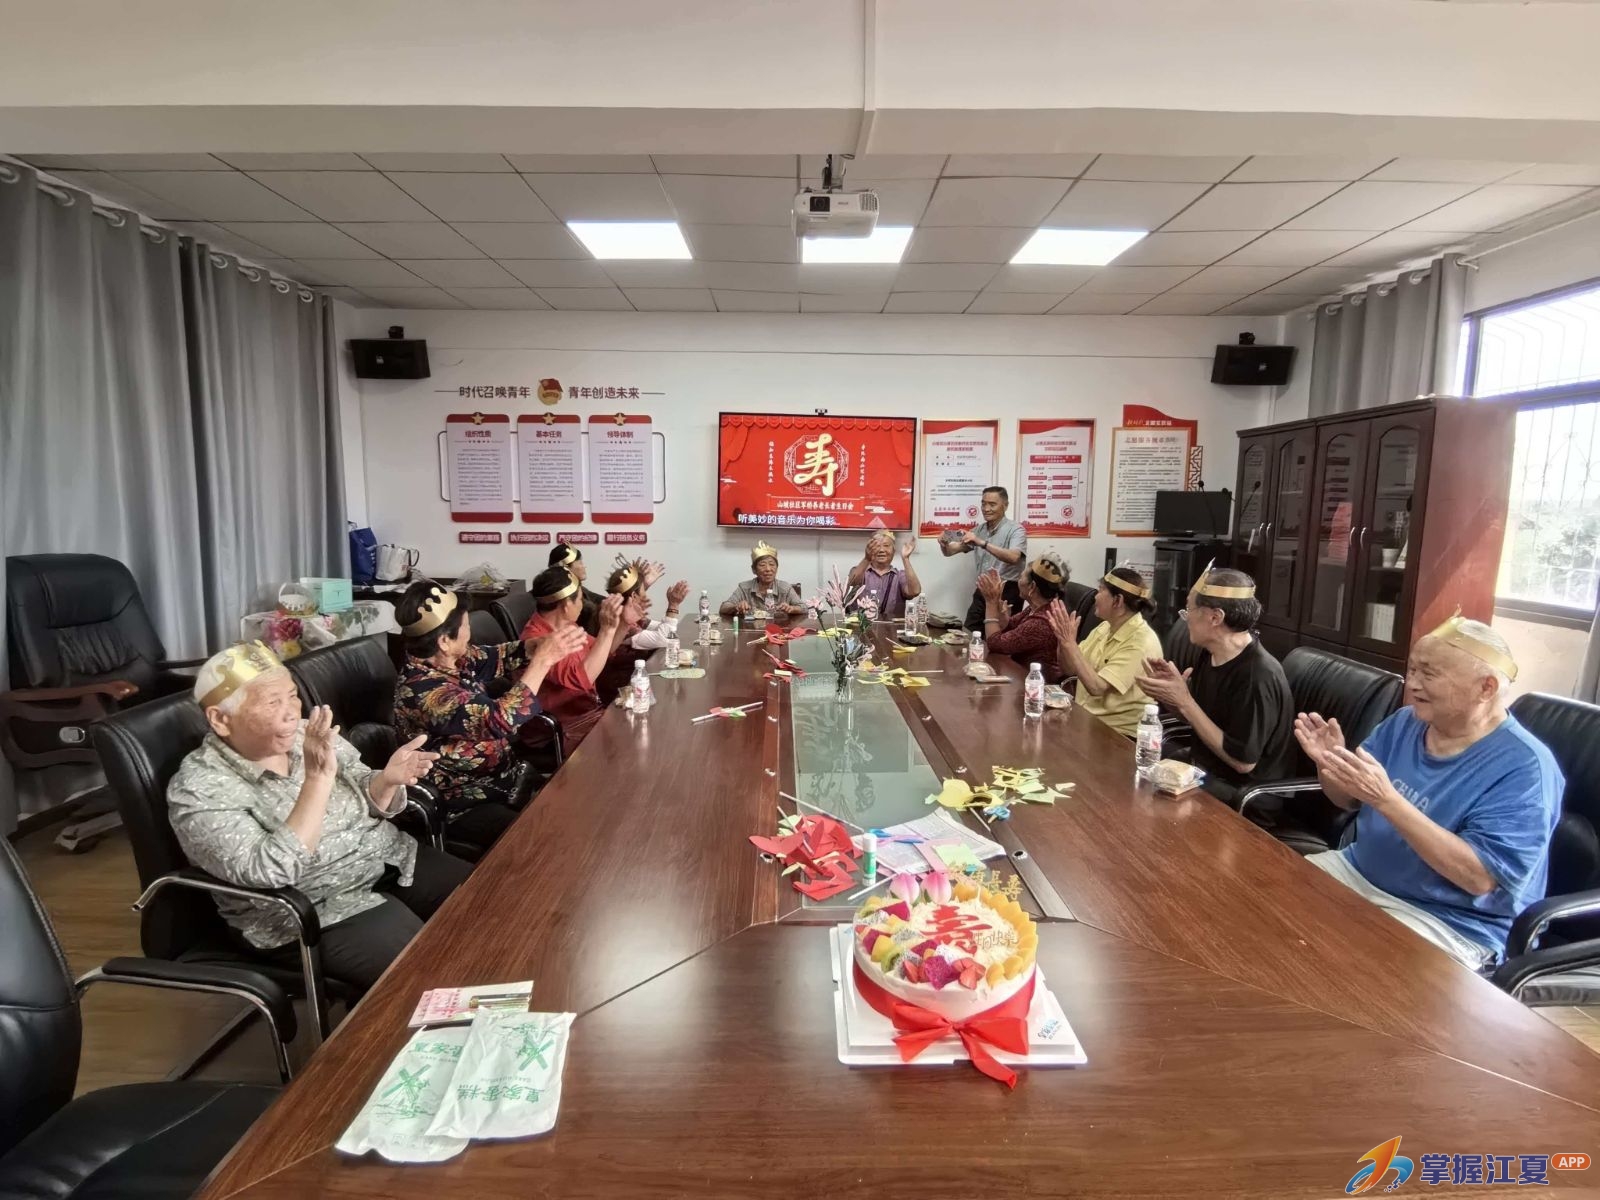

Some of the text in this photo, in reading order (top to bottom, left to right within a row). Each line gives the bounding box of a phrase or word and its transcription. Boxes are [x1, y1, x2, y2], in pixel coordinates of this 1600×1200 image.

[459, 386, 640, 399] 时代召唤青年 青年创造未来
[535, 430, 562, 438] 基本任务
[607, 430, 634, 438] 领导体制
[793, 433, 839, 497] 寿
[738, 513, 836, 526] 听美妙的音乐为你喝彩
[457, 1084, 545, 1104] 皇家蛋糕
